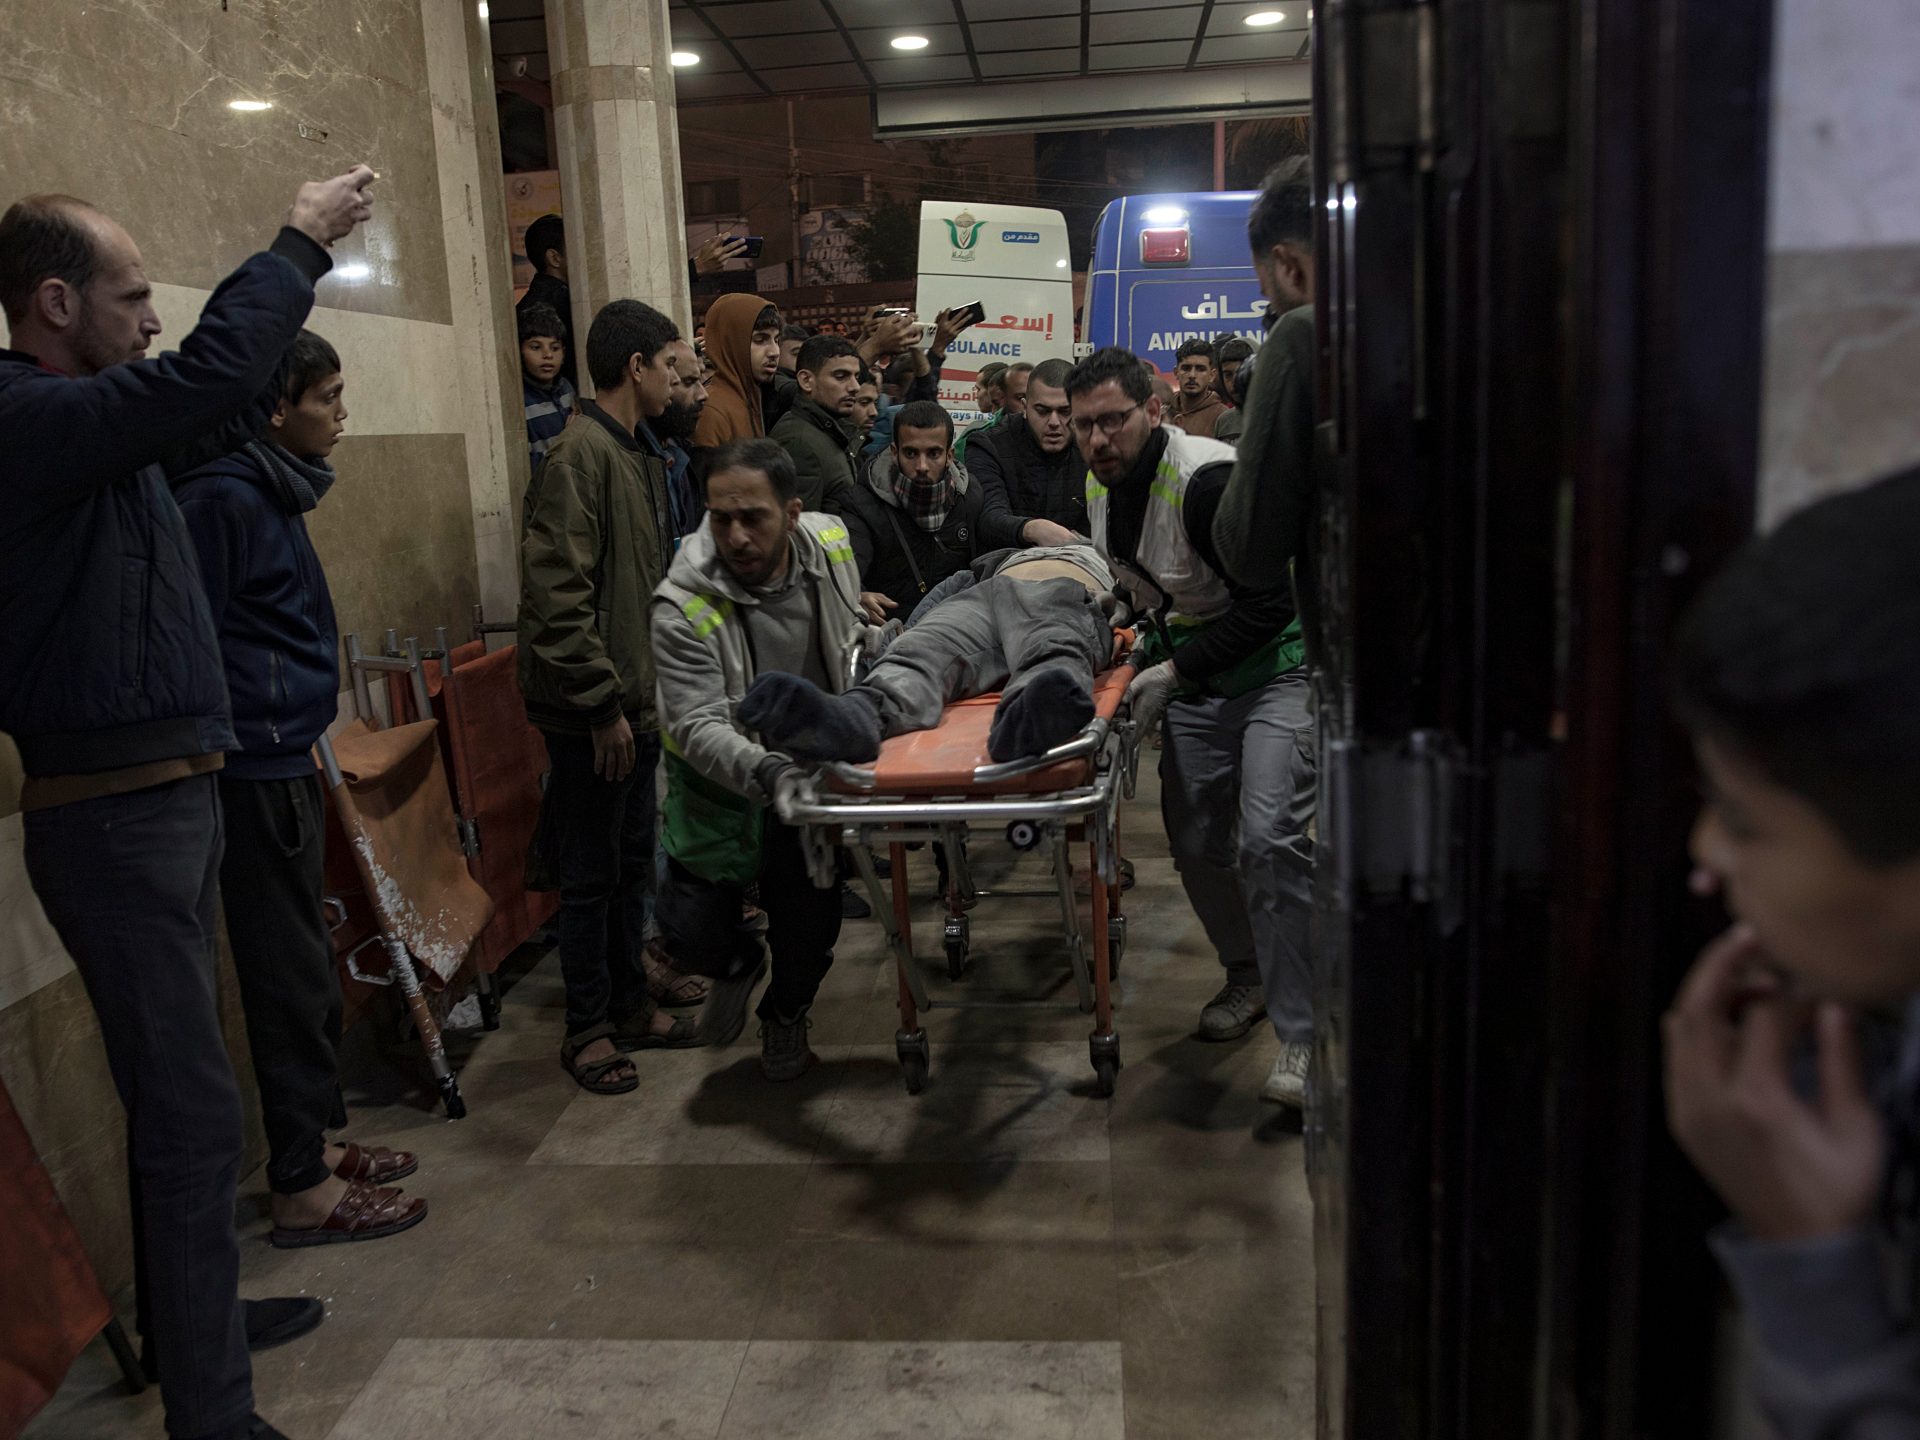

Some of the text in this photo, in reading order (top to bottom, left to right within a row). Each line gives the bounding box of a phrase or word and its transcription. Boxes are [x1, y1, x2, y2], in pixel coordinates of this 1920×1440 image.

[1181, 293, 1271, 320] عاف
[974, 313, 1054, 341] إسع
[946, 340, 1021, 356] BULANCE
[974, 412, 984, 420] in
